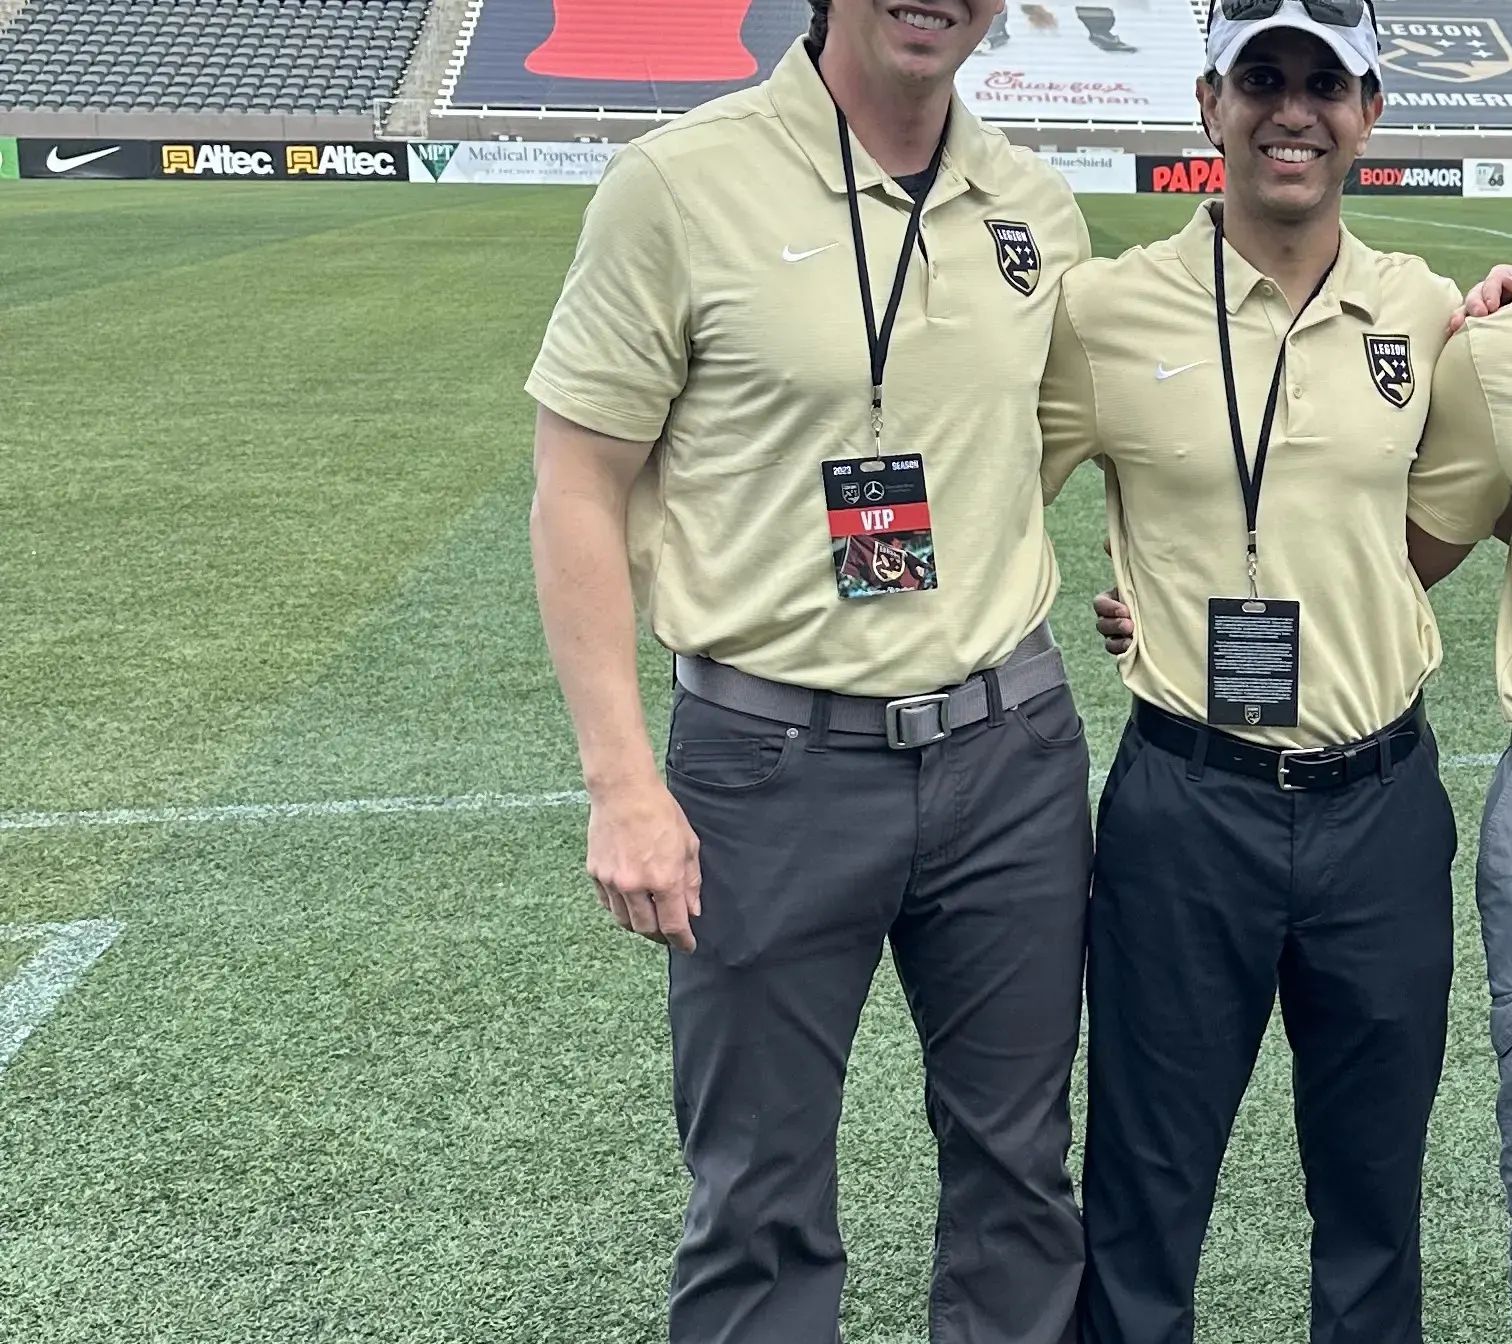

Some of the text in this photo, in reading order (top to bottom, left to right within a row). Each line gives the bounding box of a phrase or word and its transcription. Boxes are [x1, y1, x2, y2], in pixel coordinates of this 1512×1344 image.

[1378, 24, 1482, 37] LEGION
[975, 91, 1149, 105] Birmingham
[417, 144, 454, 161] MPT
[469, 146, 609, 167] Medical Properties
[996, 228, 1028, 242] LEGION
[1373, 343, 1406, 356] LEGION
[892, 460, 919, 470] SEASON
[861, 508, 895, 531] VIP
